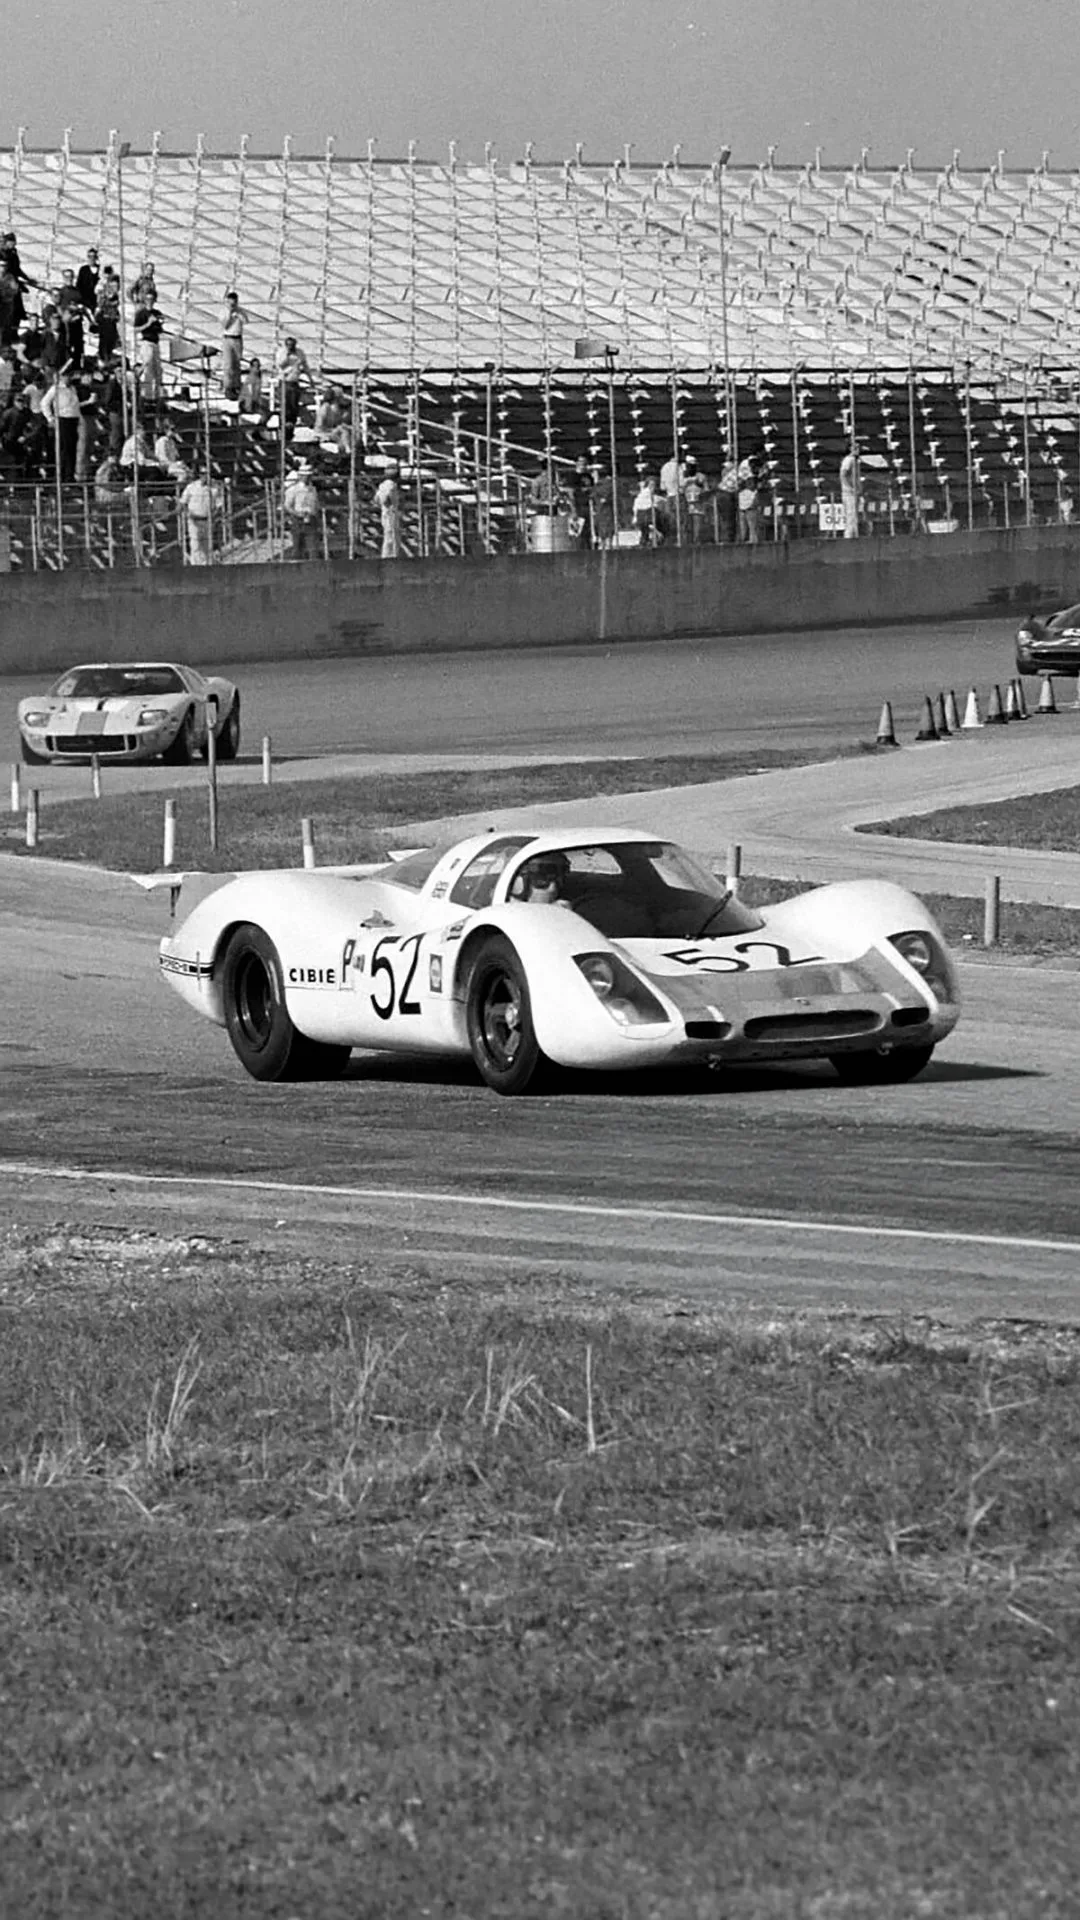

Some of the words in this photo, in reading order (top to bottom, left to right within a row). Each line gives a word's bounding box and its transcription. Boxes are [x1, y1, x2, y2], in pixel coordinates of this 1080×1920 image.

[660, 942, 825, 973] 52
[289, 968, 336, 984] CIBIE
[370, 932, 426, 1020] 52
